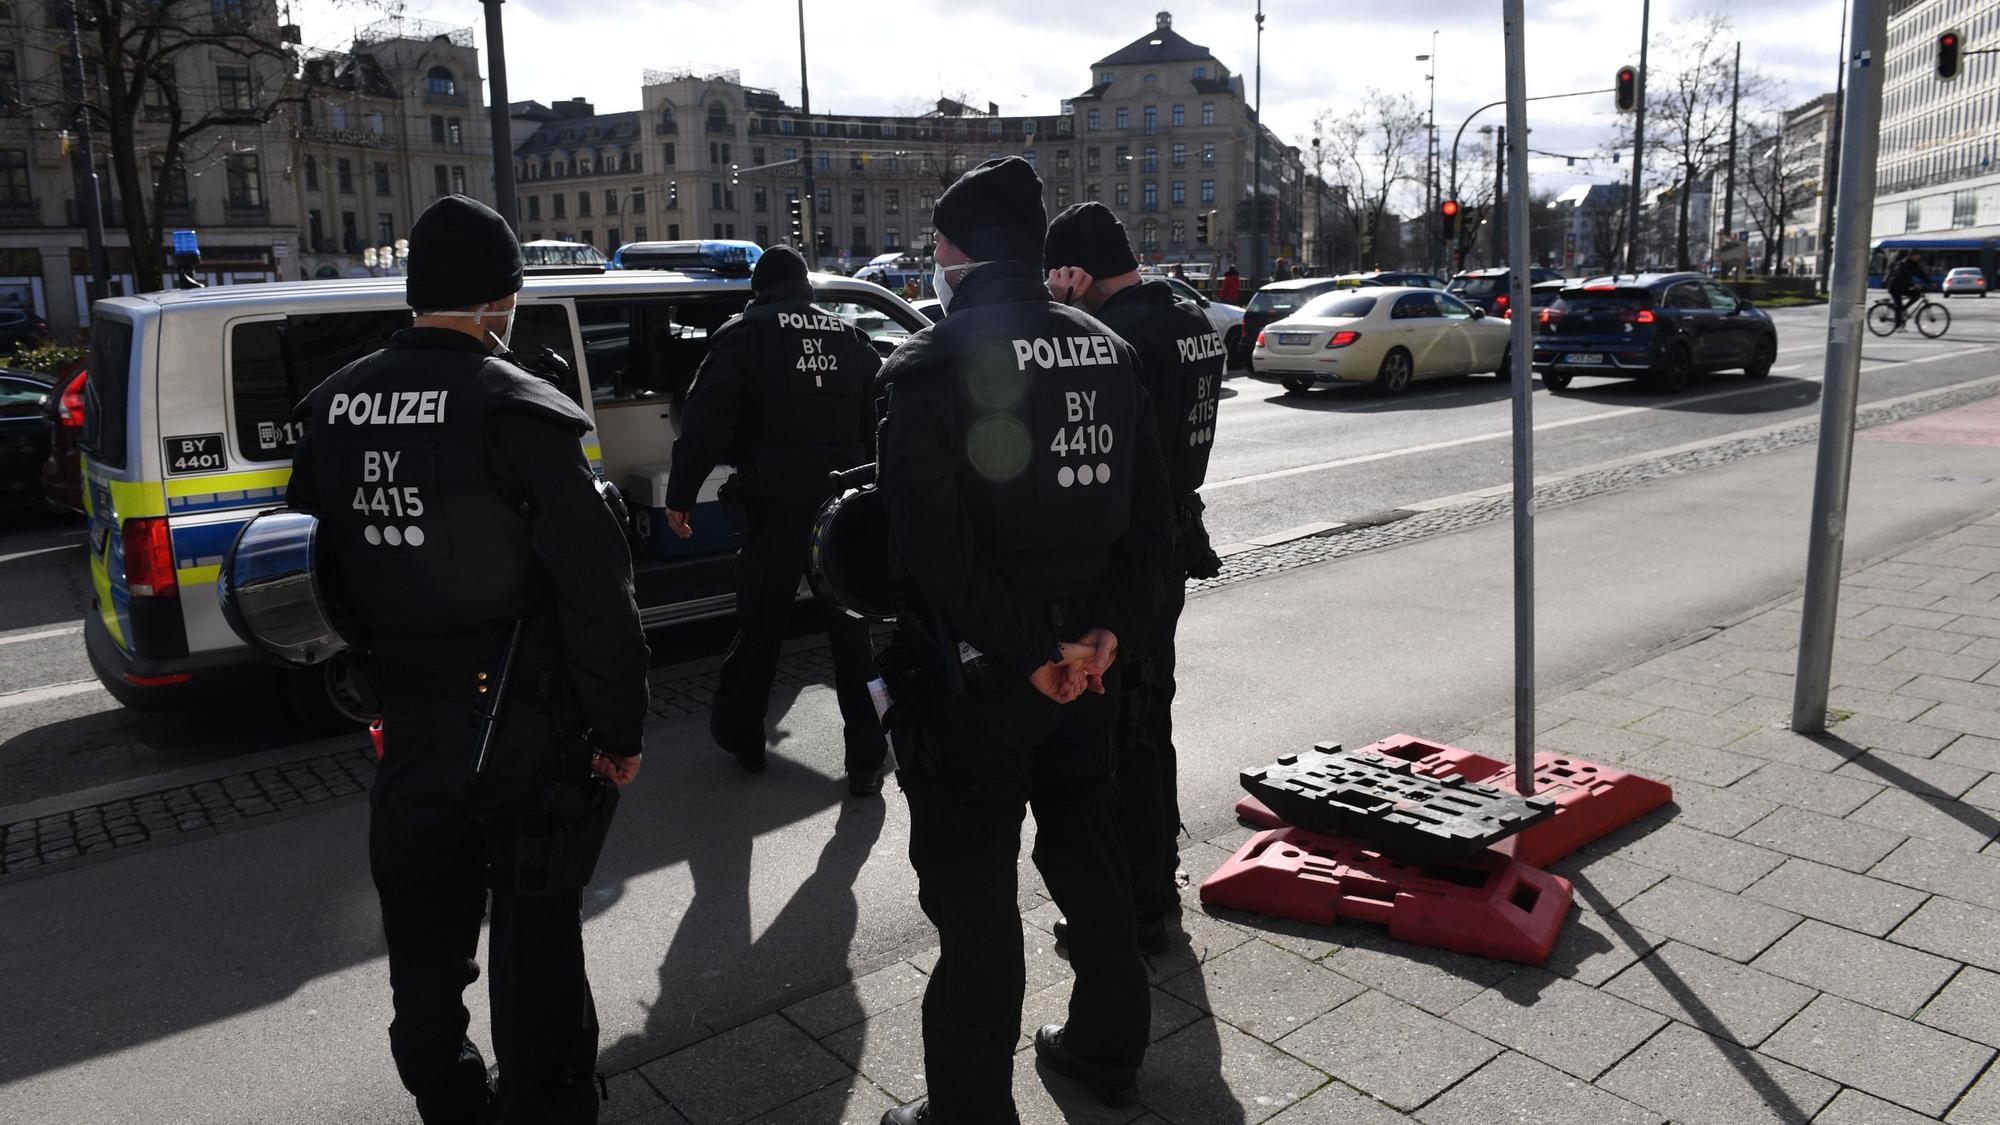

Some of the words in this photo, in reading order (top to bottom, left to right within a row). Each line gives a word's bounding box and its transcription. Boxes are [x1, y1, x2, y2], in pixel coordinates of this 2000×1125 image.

[777, 312, 846, 332] POLIZEI
[802, 338, 823, 355] BY
[1011, 335, 1119, 371] POLIZEI
[796, 354, 838, 372] 4402
[1198, 373, 1214, 400] BY
[328, 390, 449, 426] POLIZEI
[1065, 390, 1097, 423] BY
[1187, 397, 1215, 425] 4115
[181, 439, 206, 454] BY
[1050, 423, 1114, 457] 4410
[175, 453, 221, 470] 4401
[364, 450, 401, 483] BY
[352, 486, 424, 517] 4415
